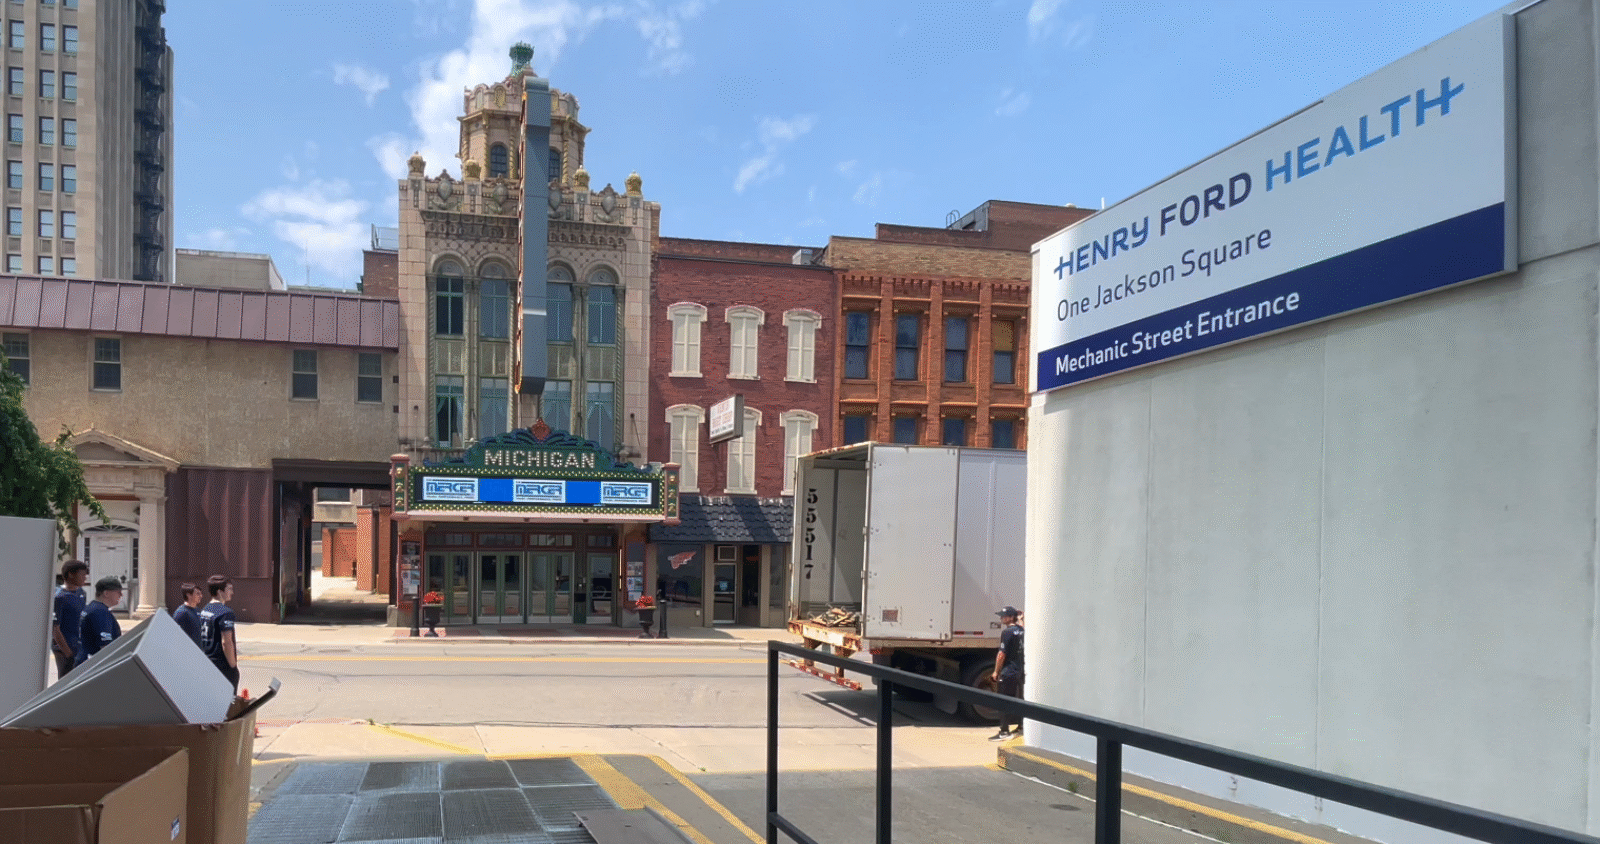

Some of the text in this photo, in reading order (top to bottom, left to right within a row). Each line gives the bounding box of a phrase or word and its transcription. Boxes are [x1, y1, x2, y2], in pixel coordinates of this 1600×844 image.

[1053, 76, 1466, 280] HENRY FORD HEALTH
[1057, 228, 1272, 321] One Jackson Square
[1055, 292, 1300, 376] Mechanic Street Entrance
[426, 482, 475, 492] MERCER
[484, 449, 596, 469] MICHIGAN
[803, 488, 818, 580] 55517
